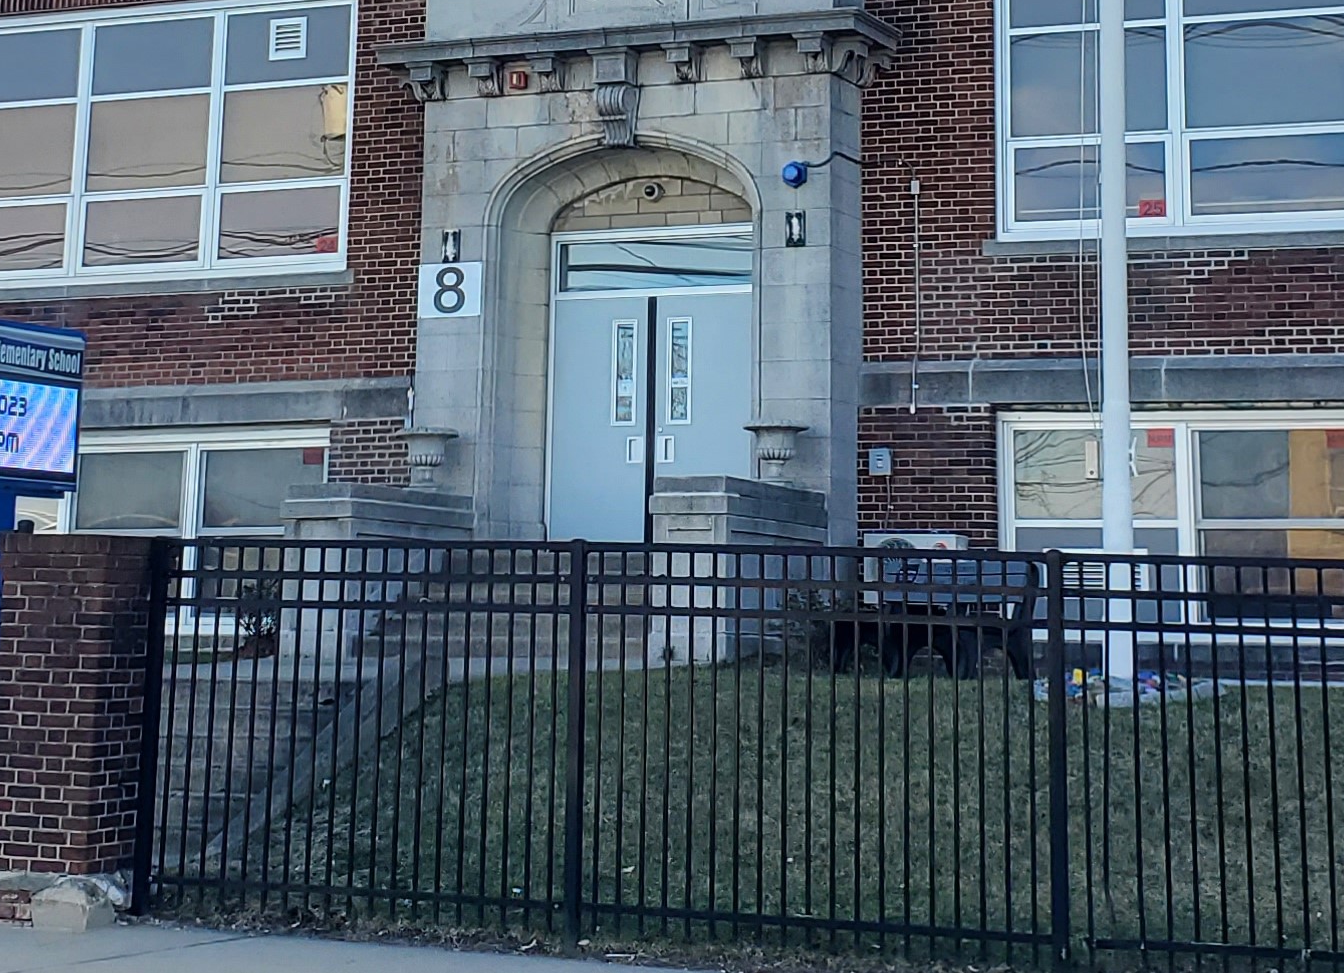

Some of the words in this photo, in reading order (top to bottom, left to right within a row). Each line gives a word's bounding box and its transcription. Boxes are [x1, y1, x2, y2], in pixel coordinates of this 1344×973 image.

[1143, 202, 1163, 216] 25
[433, 266, 466, 315] 8
[48, 348, 81, 374] School
